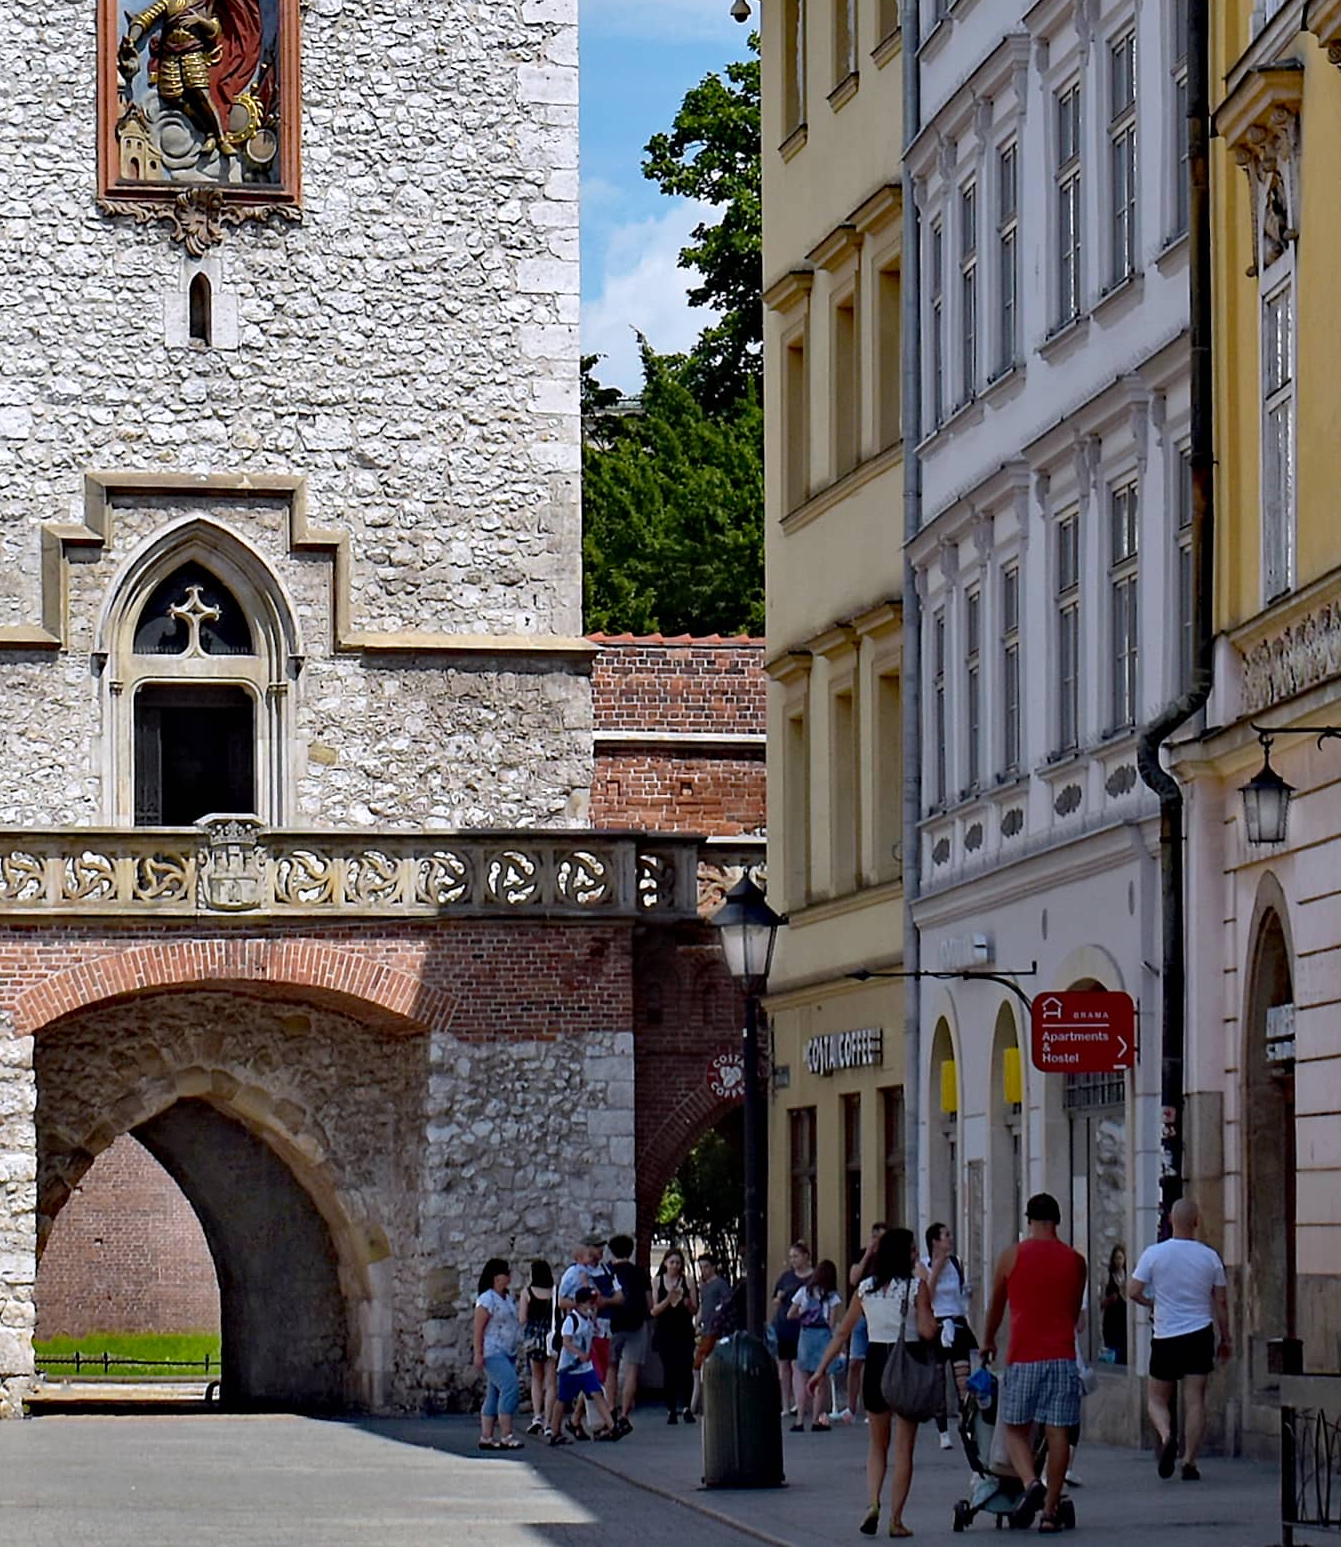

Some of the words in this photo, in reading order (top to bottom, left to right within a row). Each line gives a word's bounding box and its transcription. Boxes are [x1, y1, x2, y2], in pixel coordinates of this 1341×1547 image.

[1073, 1011, 1109, 1019] BRAMA
[1042, 1031, 1109, 1042] Apartments
[1043, 1042, 1051, 1053] &
[1042, 1053, 1079, 1063] Hostel
